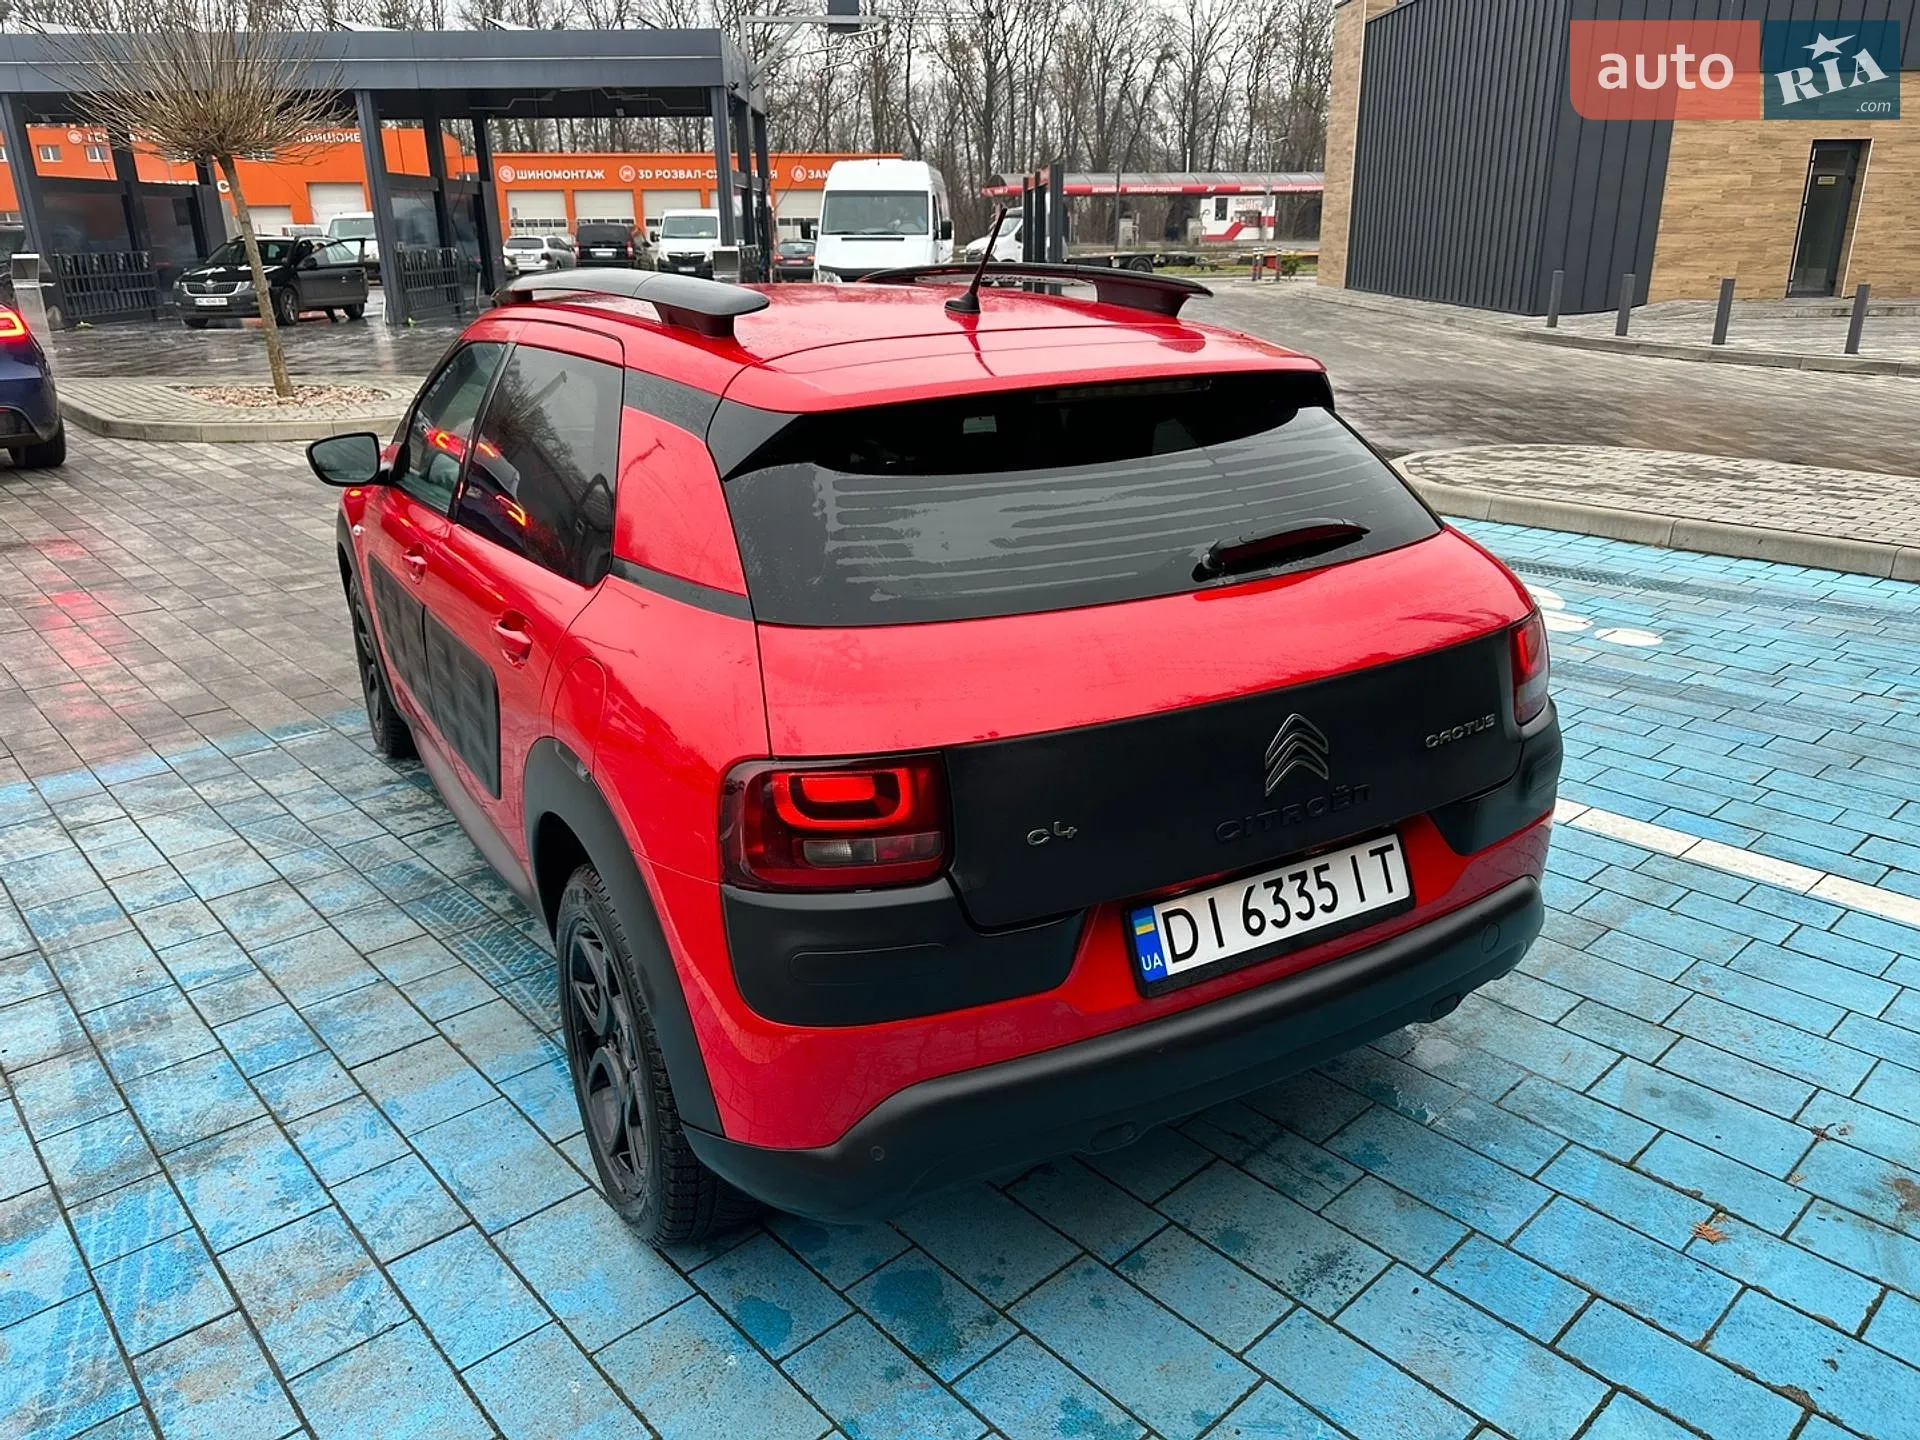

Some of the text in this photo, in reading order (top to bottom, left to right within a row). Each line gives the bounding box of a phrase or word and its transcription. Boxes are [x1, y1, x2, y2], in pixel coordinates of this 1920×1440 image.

[516, 168, 605, 180] ШИНОМОНТАЖ
[638, 168, 653, 180] 3D
[1425, 713, 1495, 748] CACTUS
[1161, 843, 1395, 964] DI 6335 IT
[1141, 951, 1164, 972] UA
